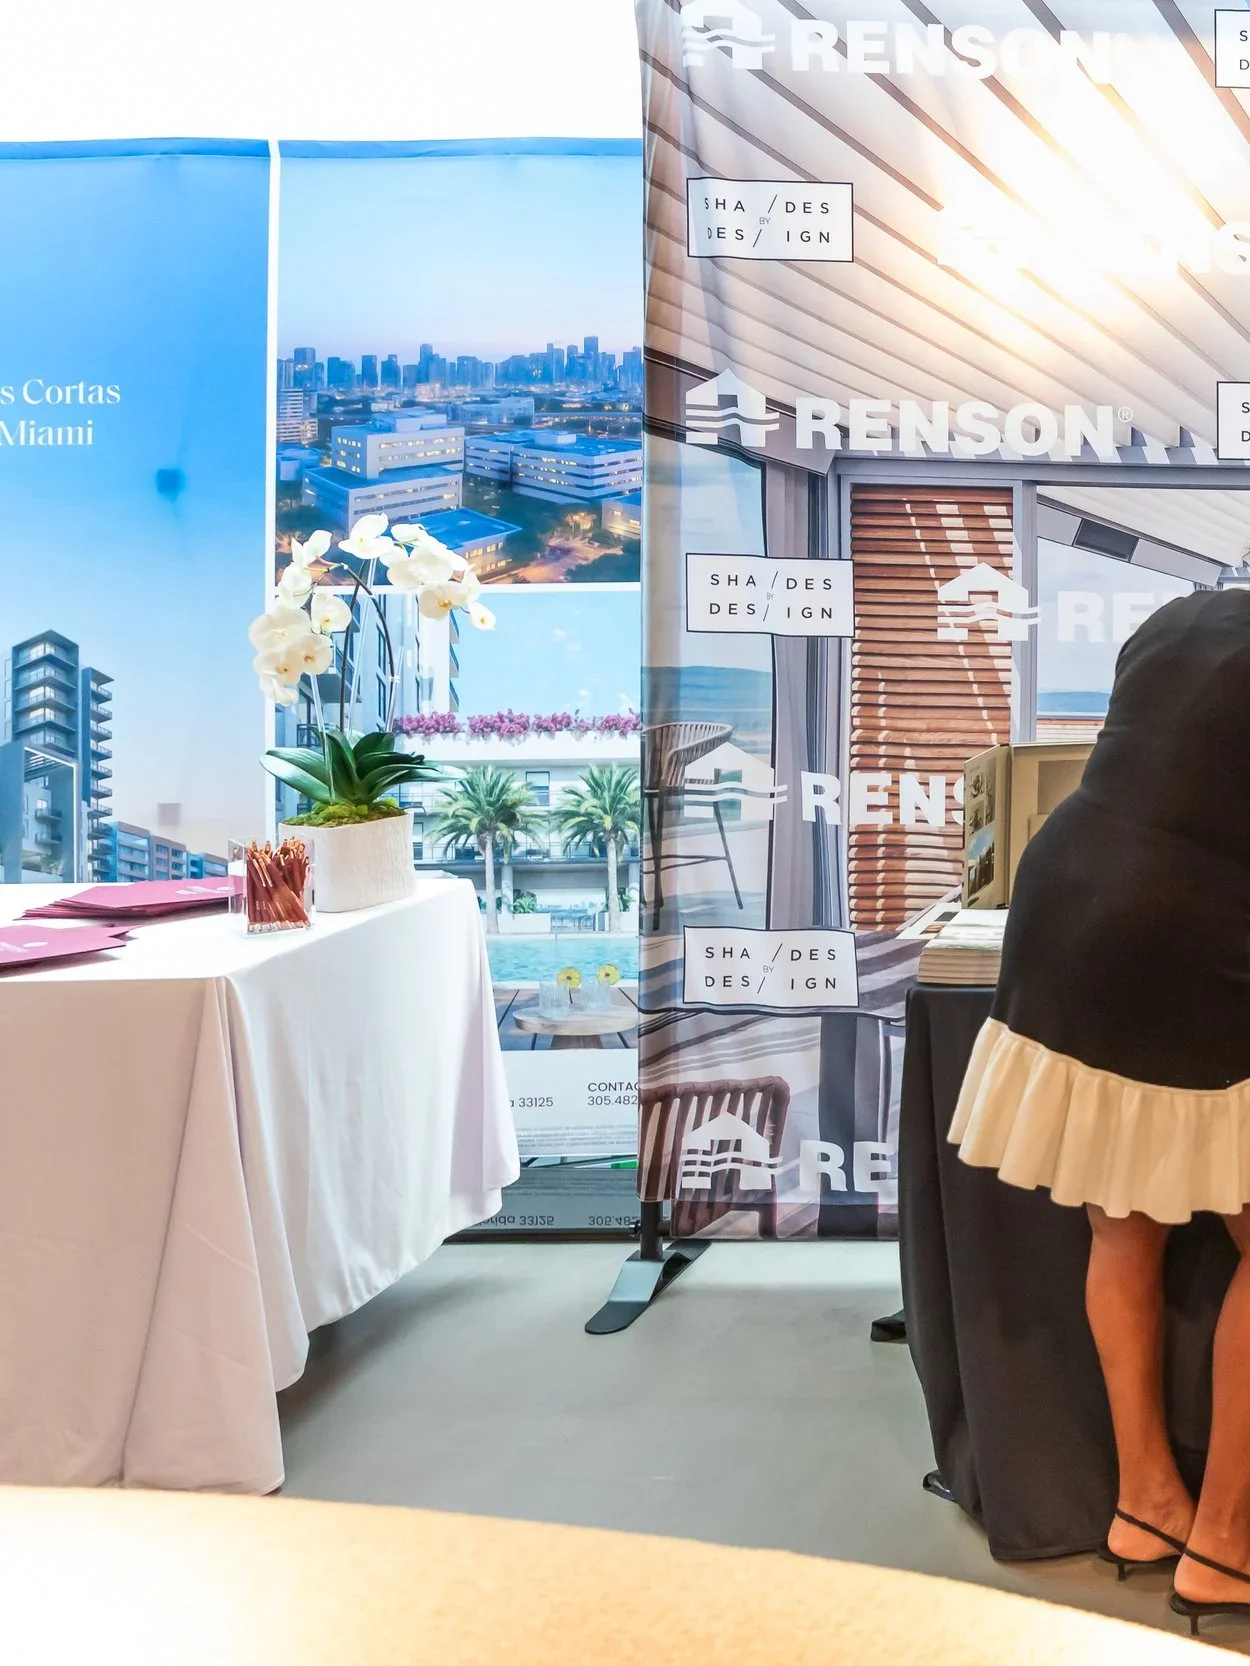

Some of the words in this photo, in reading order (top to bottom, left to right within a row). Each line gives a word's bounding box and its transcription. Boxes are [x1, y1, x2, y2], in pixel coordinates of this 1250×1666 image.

[704, 197, 746, 213] SHA
[786, 230, 830, 244] IGN
[22, 379, 121, 405] Cortas
[0, 419, 94, 446] Miami
[710, 573, 757, 587] SHA
[787, 606, 833, 621] IGN
[704, 946, 751, 960] SHA
[790, 977, 836, 991] IGN
[518, 1096, 554, 1108] 33125
[587, 1095, 638, 1106] 305.482
